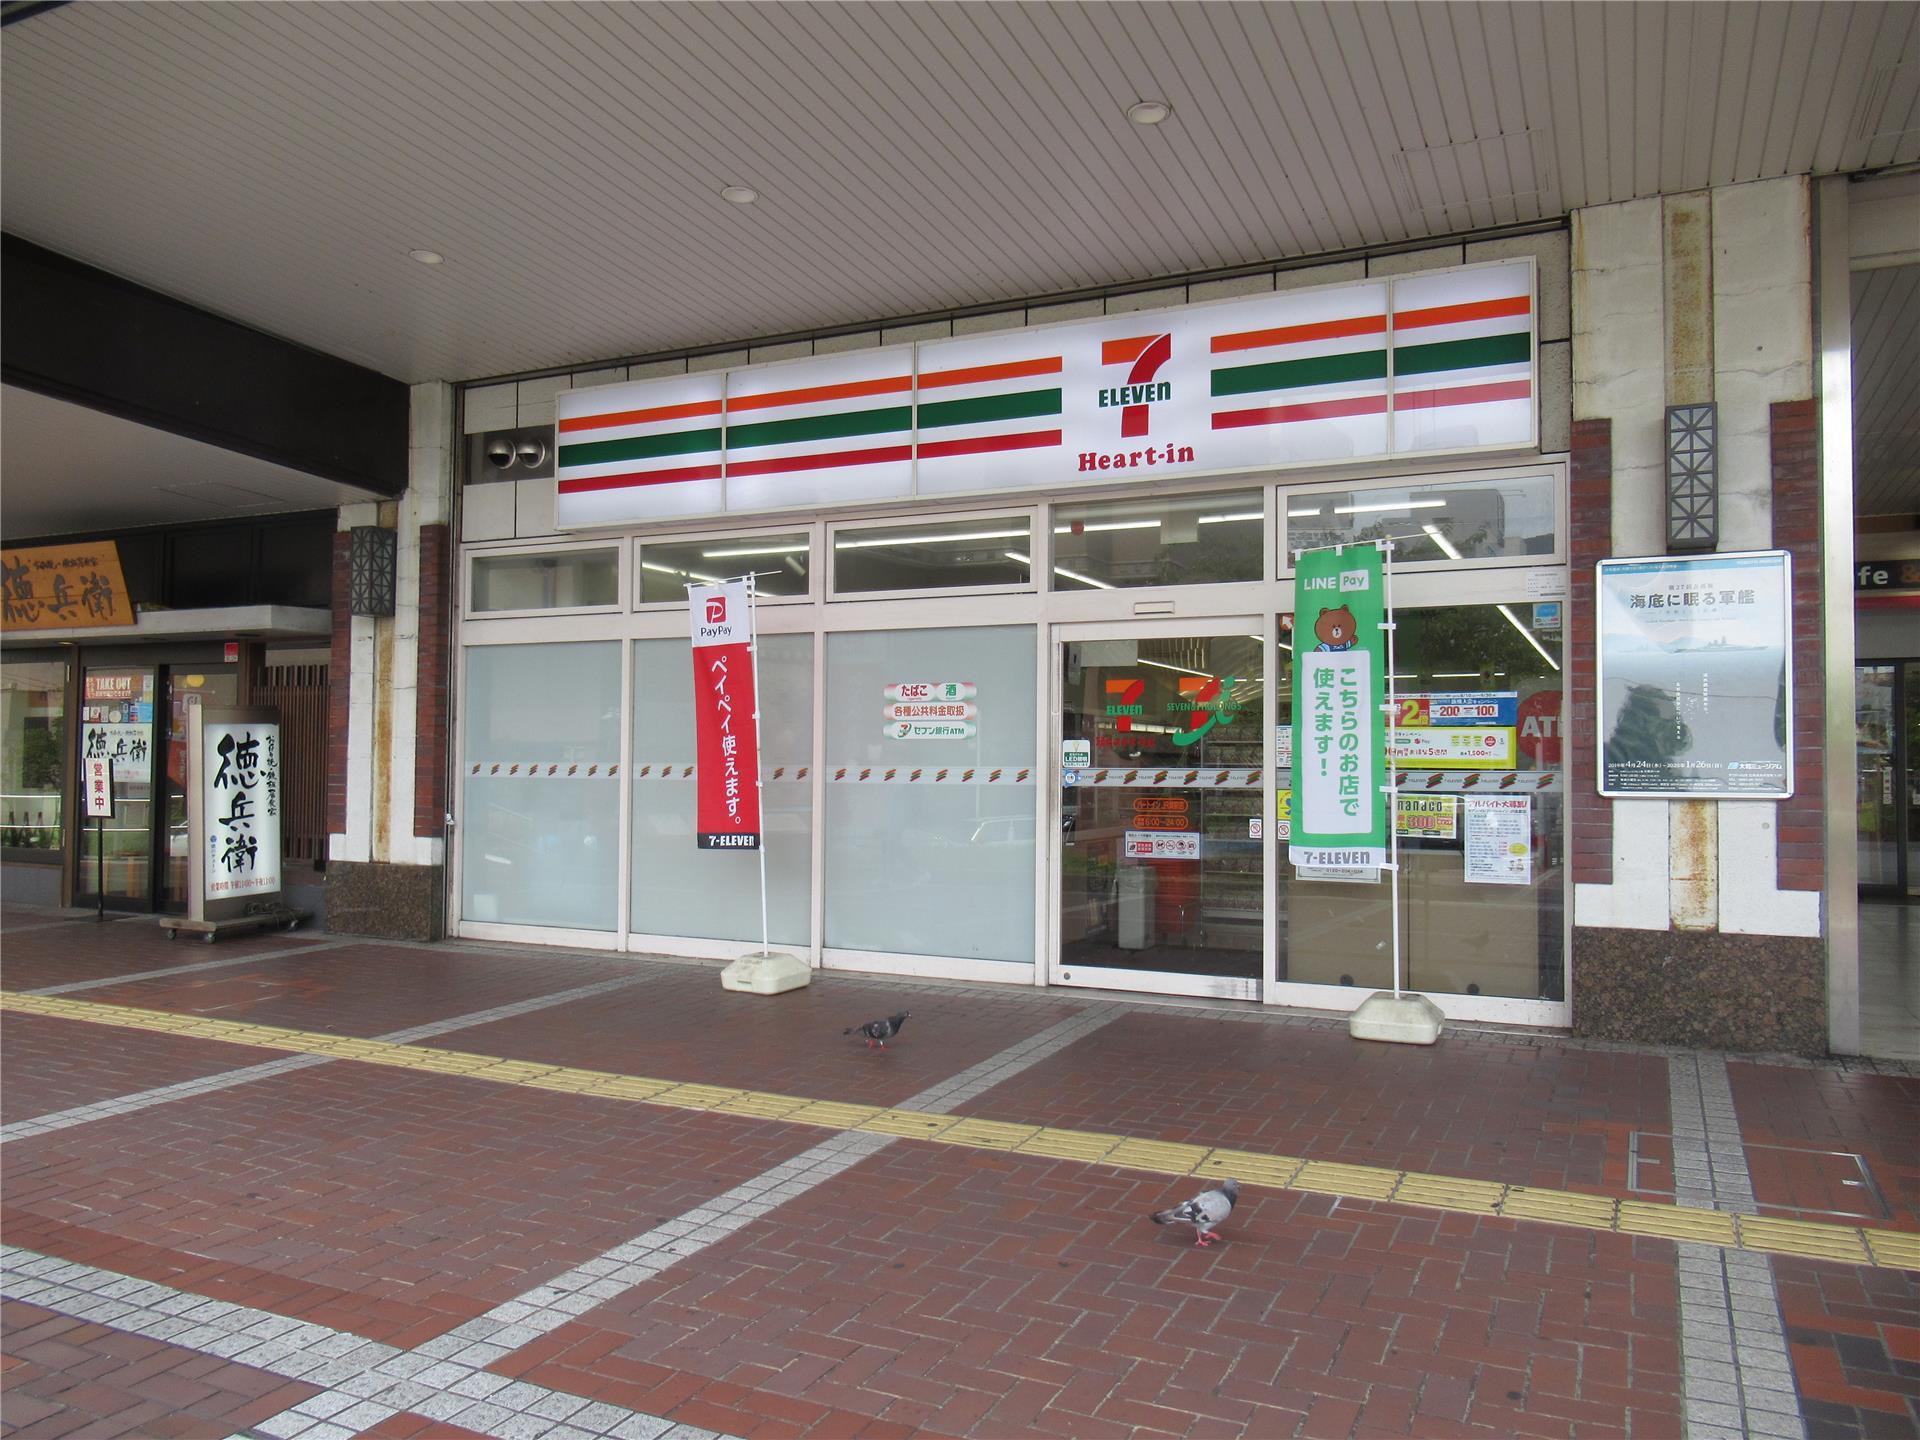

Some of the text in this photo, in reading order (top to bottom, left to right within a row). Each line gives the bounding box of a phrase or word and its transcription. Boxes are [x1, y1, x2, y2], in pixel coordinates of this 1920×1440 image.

[1303, 575, 1365, 590] LINE Pay
[1630, 589, 1755, 609] 海底に眠る軍艦
[700, 625, 732, 638] PayPay
[96, 677, 114, 690] TAKE
[115, 677, 131, 690] OUT
[901, 684, 957, 697] たばこ 酒
[894, 705, 965, 717] 各種公共料金取扱
[914, 726, 965, 735] セブン銀行ATM
[1521, 715, 1562, 737] AT
[712, 655, 741, 824] ペイペイ使えます。
[1339, 668, 1360, 817] こちらのお店で
[93, 763, 104, 810] 営業中
[214, 731, 266, 873] 徳兵衛
[1397, 800, 1442, 812] nanaco
